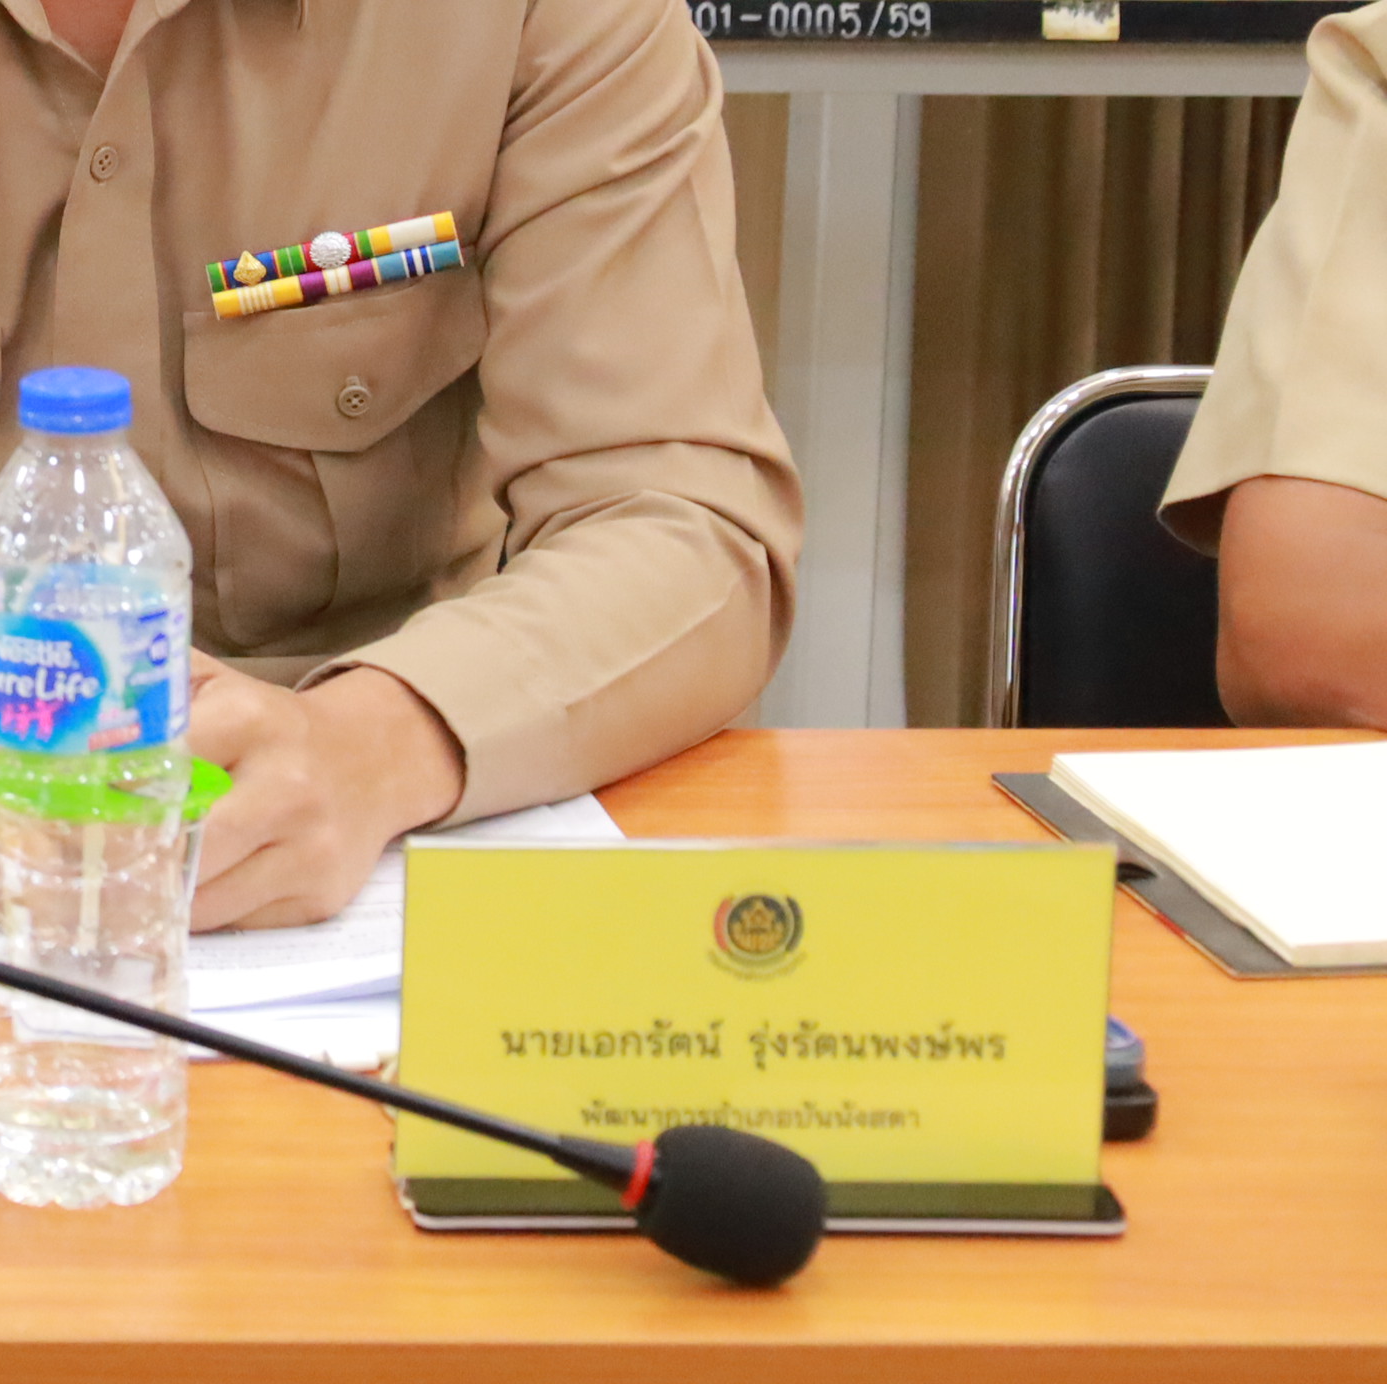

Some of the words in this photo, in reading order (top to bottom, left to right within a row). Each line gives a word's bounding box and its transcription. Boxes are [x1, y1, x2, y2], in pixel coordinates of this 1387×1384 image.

[689, 0, 932, 39] 01-0005/59
[500, 1019, 724, 1059] นายเอกรัตน์
[748, 1020, 1006, 1071] รุ่งรัตนพงษ์พร
